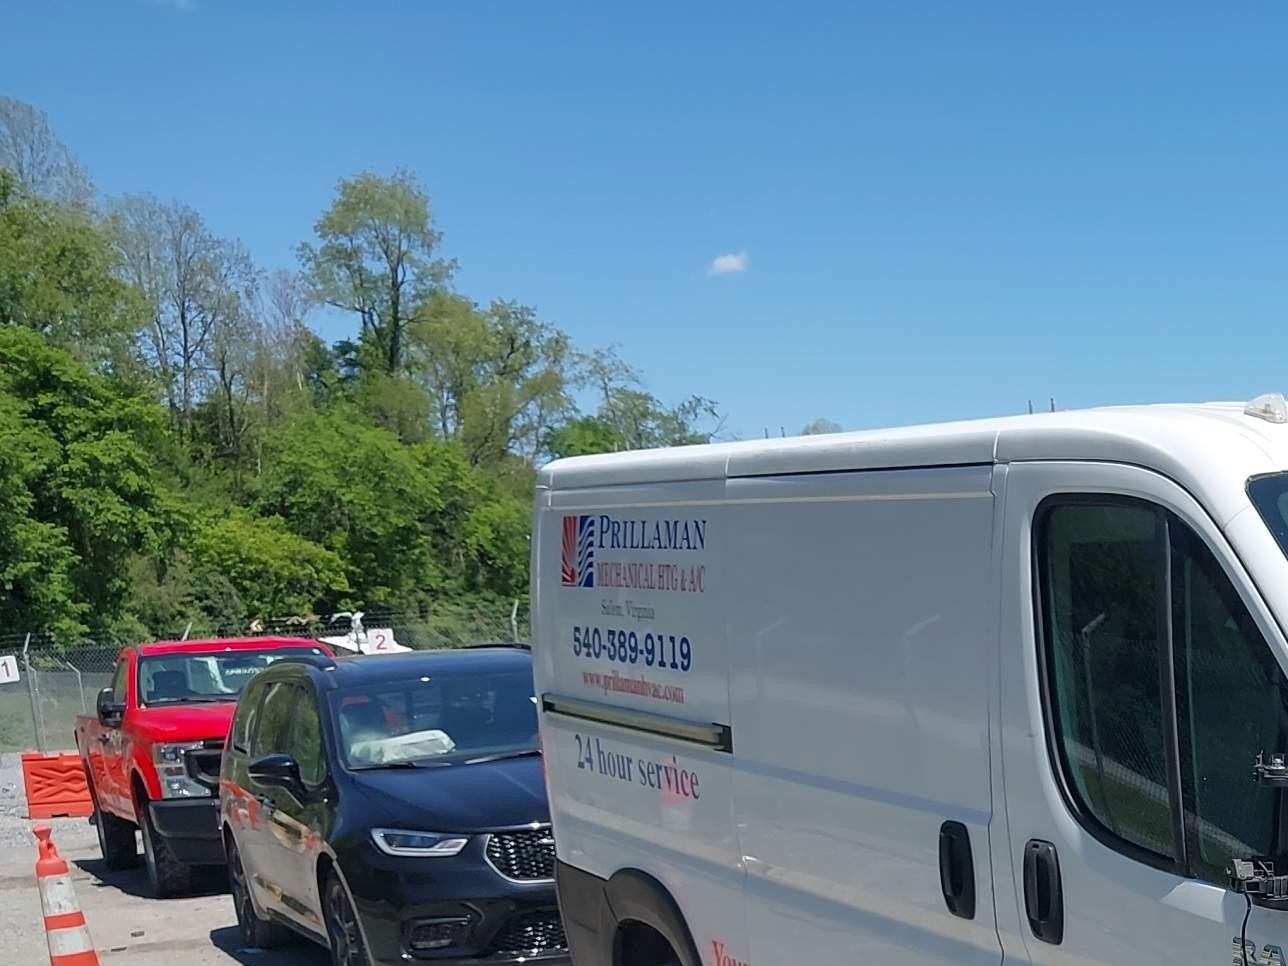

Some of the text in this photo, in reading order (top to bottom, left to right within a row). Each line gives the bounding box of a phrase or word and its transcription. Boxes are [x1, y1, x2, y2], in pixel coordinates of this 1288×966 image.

[598, 515, 706, 549] PRILLAMAN
[597, 562, 656, 590] MECHANICAL
[658, 564, 679, 591] HTG
[375, 634, 388, 650] 2
[573, 626, 692, 672] 540-389-9119
[575, 733, 701, 800] 24 hour service
